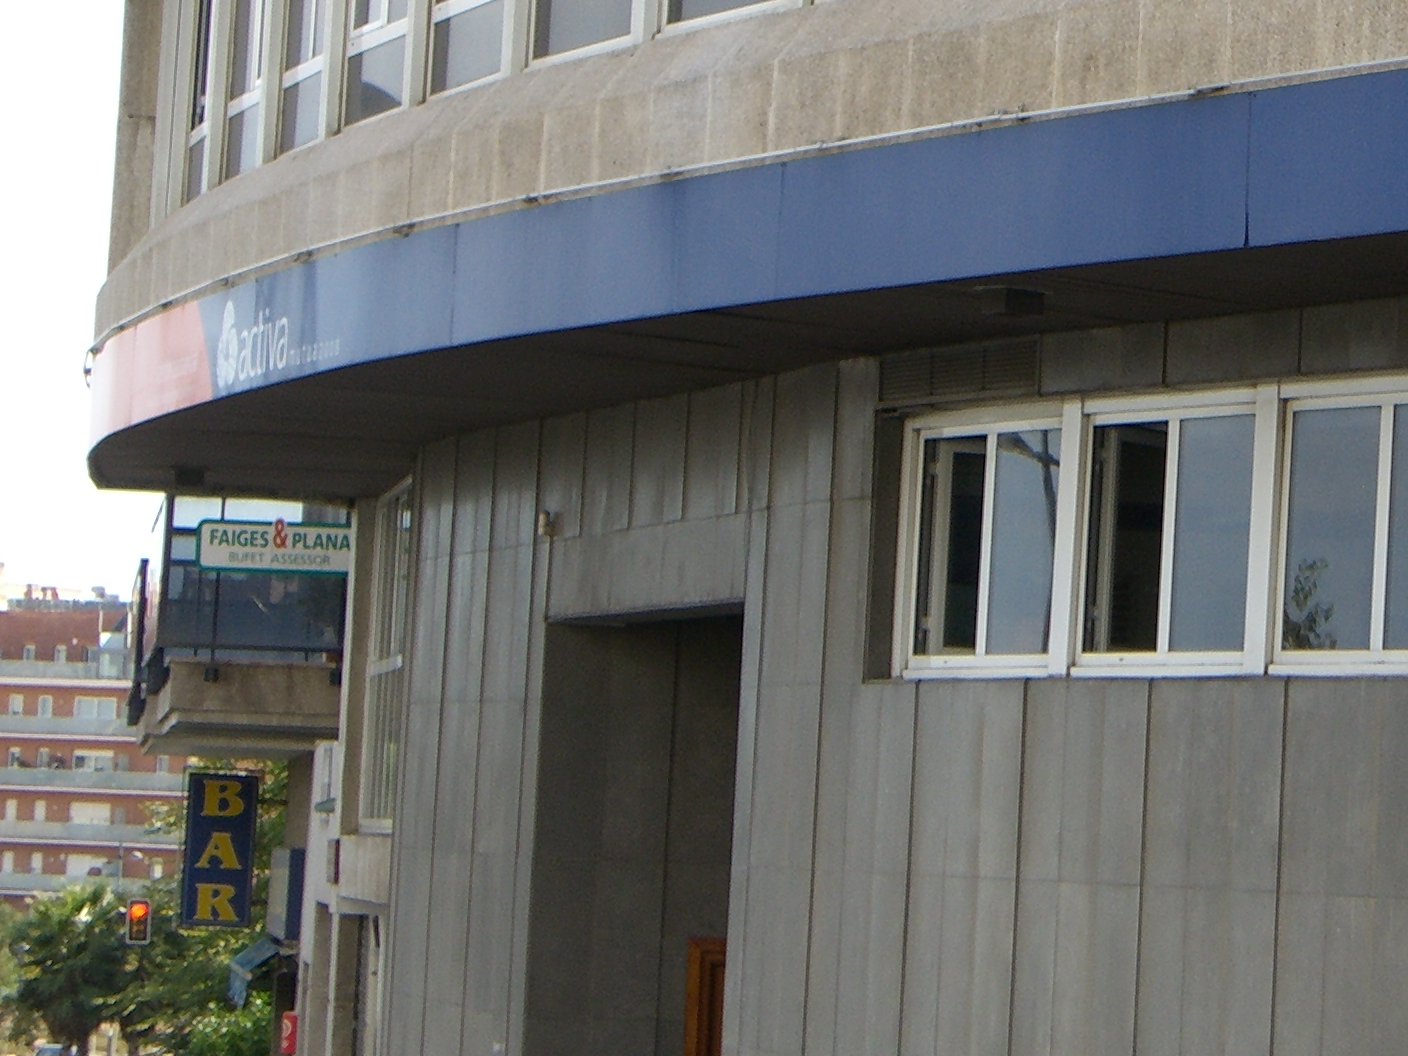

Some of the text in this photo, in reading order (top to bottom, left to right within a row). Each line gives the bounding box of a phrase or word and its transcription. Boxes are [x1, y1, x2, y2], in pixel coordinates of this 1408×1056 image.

[238, 307, 289, 381] activa
[209, 518, 350, 551] FAIGES & PLANA
[228, 551, 264, 563] BUFET
[193, 779, 244, 921] BAR
